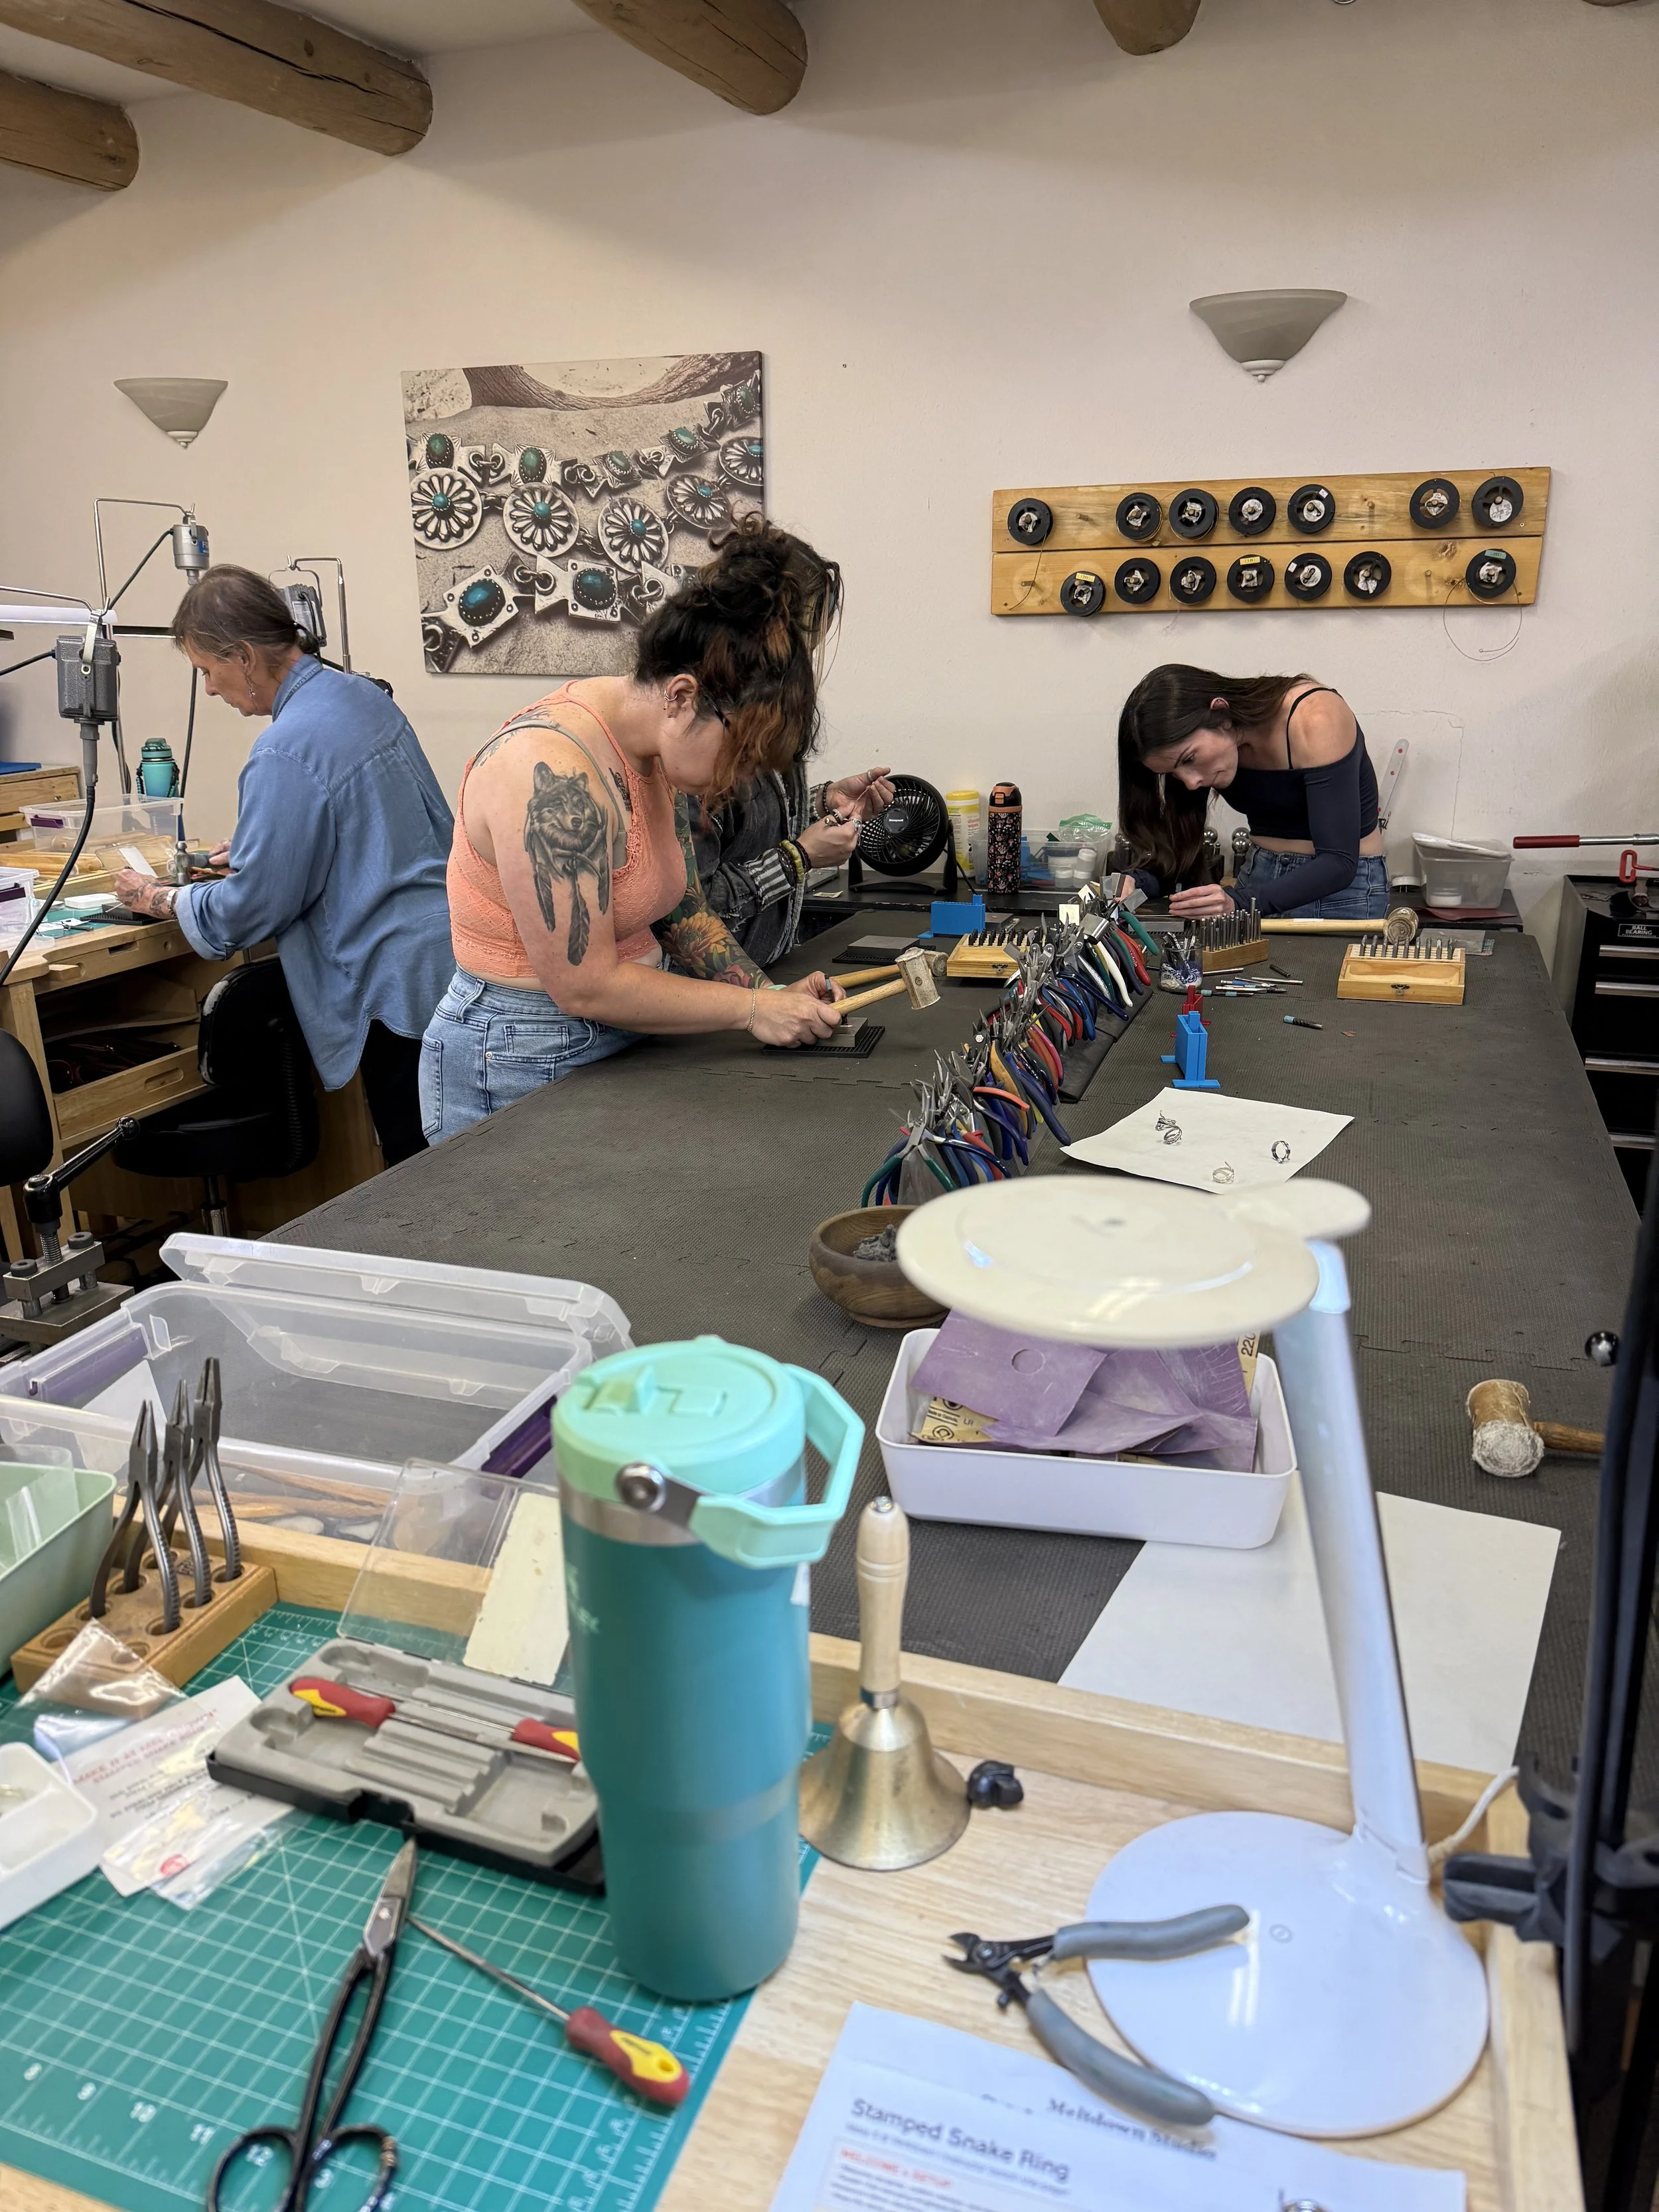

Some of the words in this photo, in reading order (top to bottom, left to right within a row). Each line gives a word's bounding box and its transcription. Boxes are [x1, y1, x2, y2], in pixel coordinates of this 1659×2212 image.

[246, 2143, 274, 2167] 12
[850, 2096, 943, 2142] Stamped
[948, 2126, 1015, 2162] Snake
[1017, 2148, 1071, 2185] Ring
